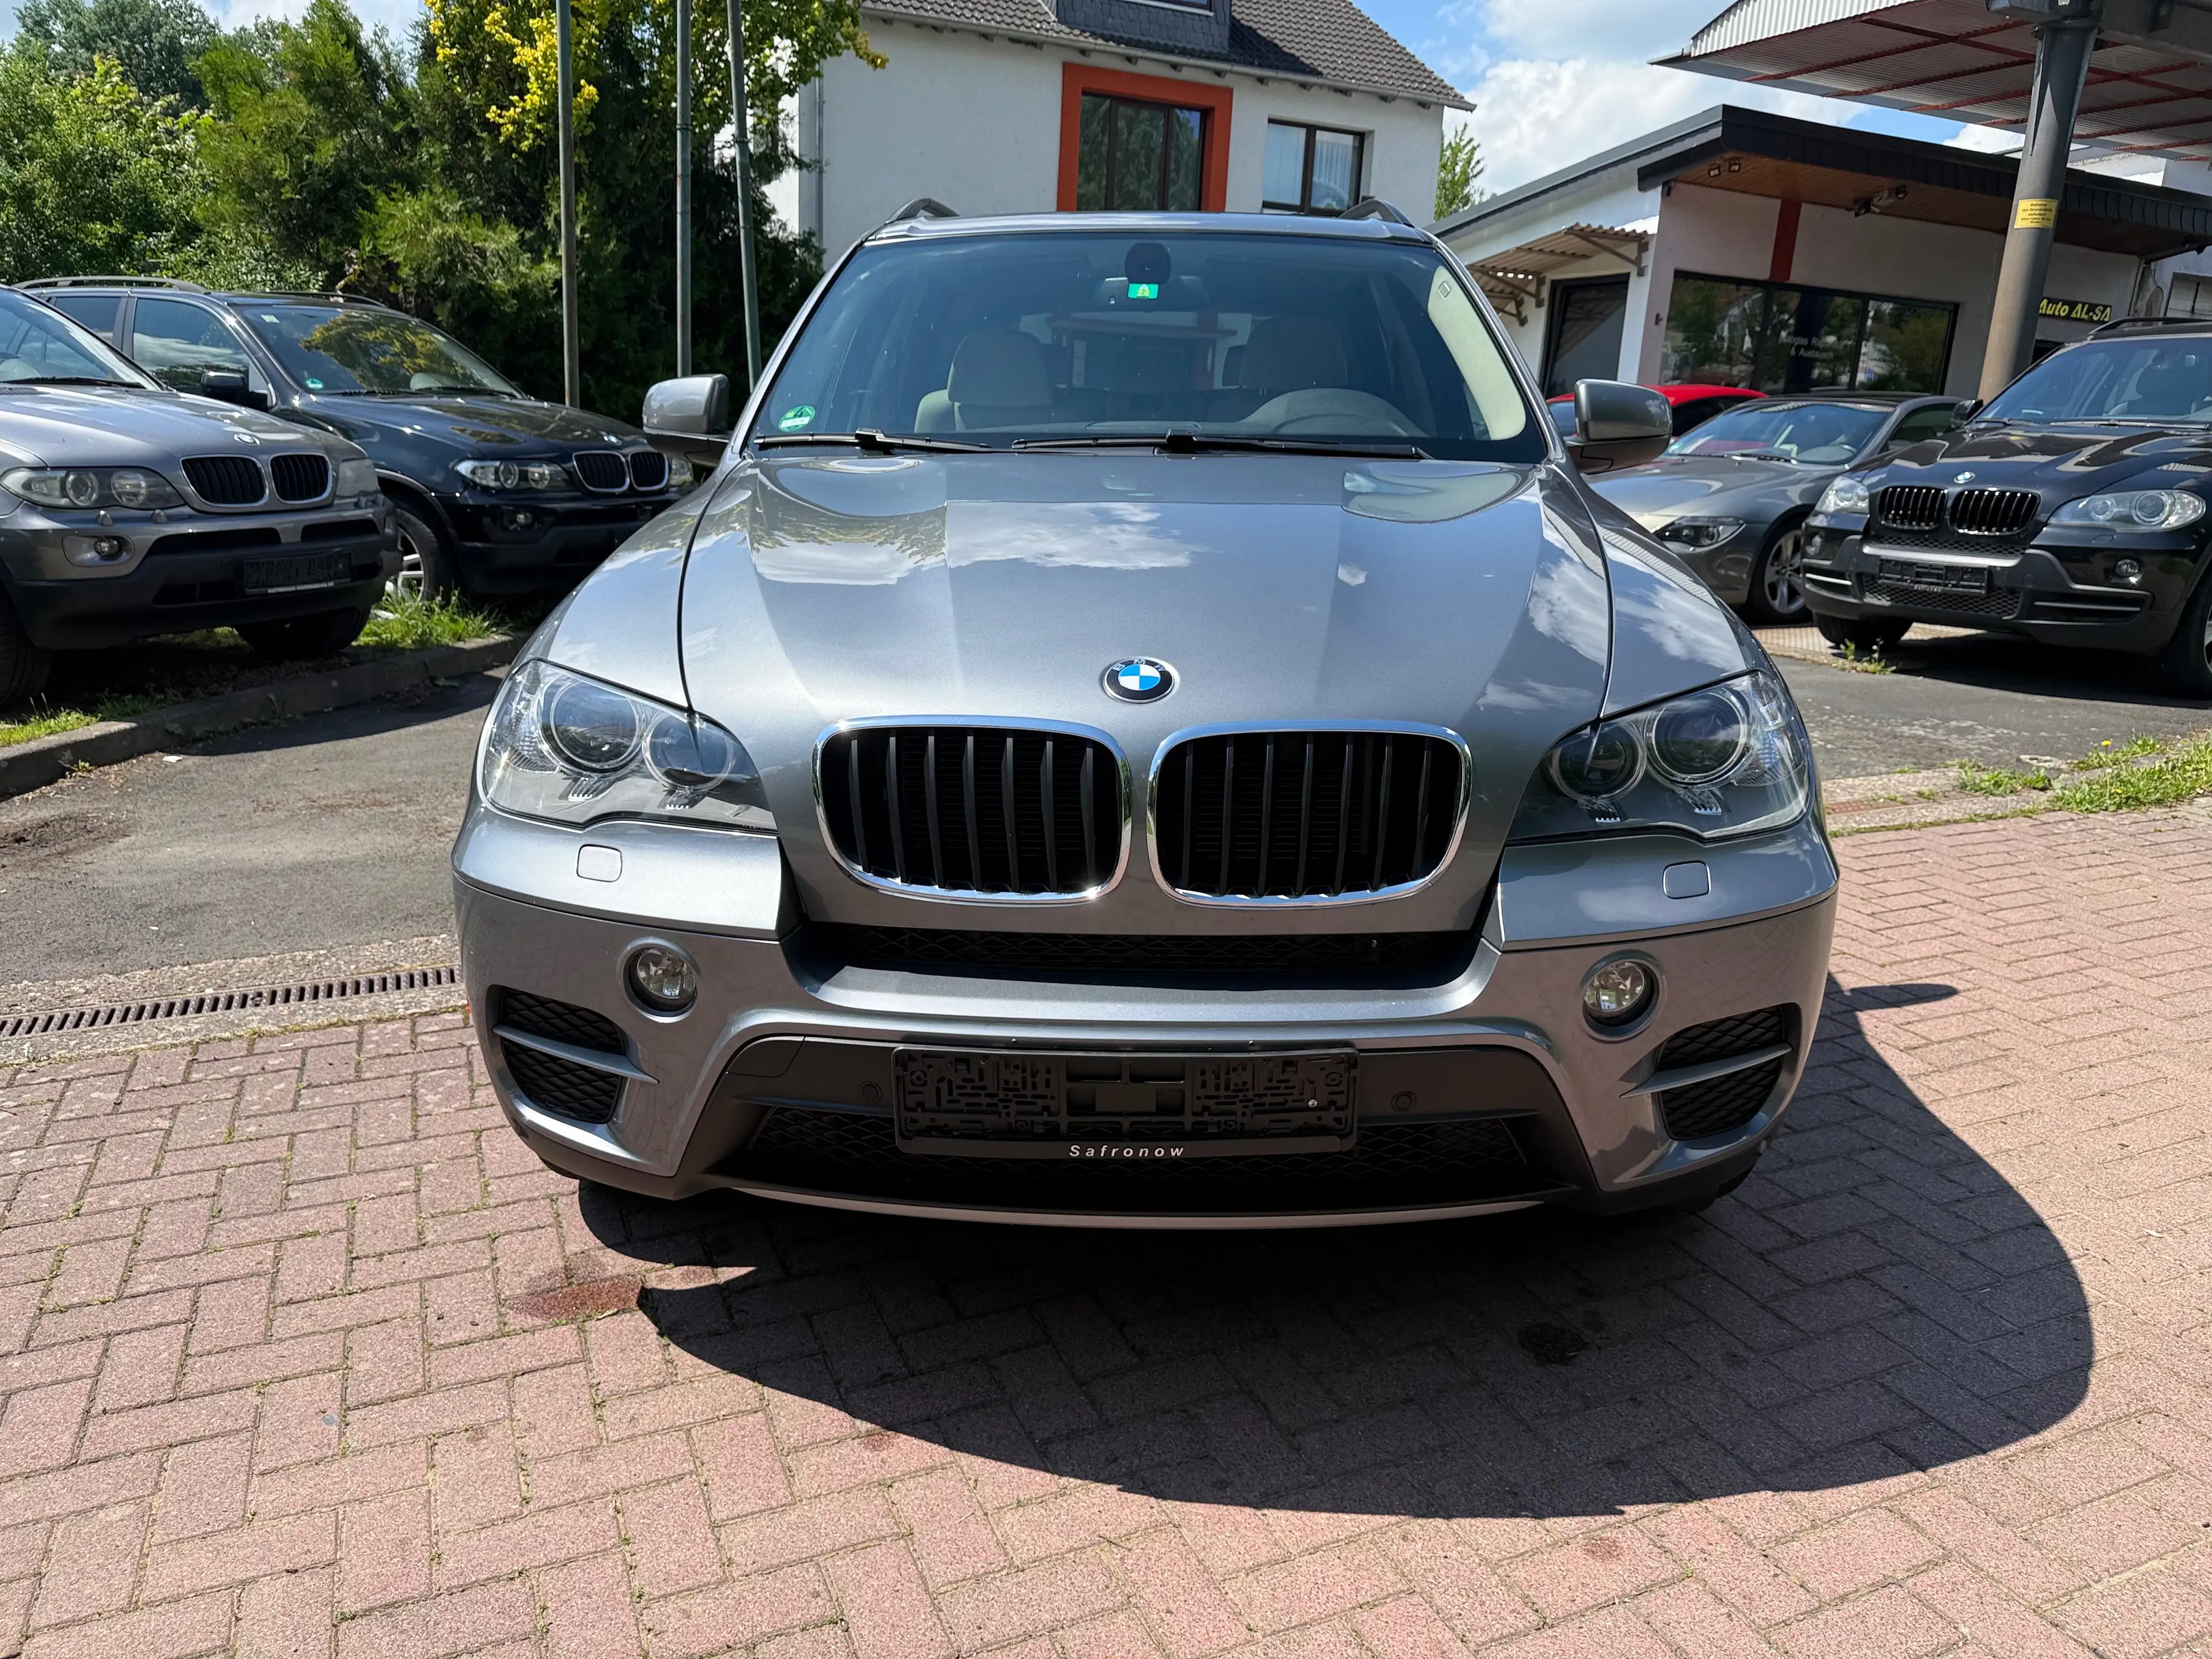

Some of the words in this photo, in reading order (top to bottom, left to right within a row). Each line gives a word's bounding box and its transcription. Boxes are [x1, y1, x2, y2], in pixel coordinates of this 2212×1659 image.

[2039, 298, 2070, 317] Auto
[2070, 302, 2111, 322] AL-SA
[1112, 659, 1166, 671] BMW
[1069, 1145, 1184, 1157] Safronow
